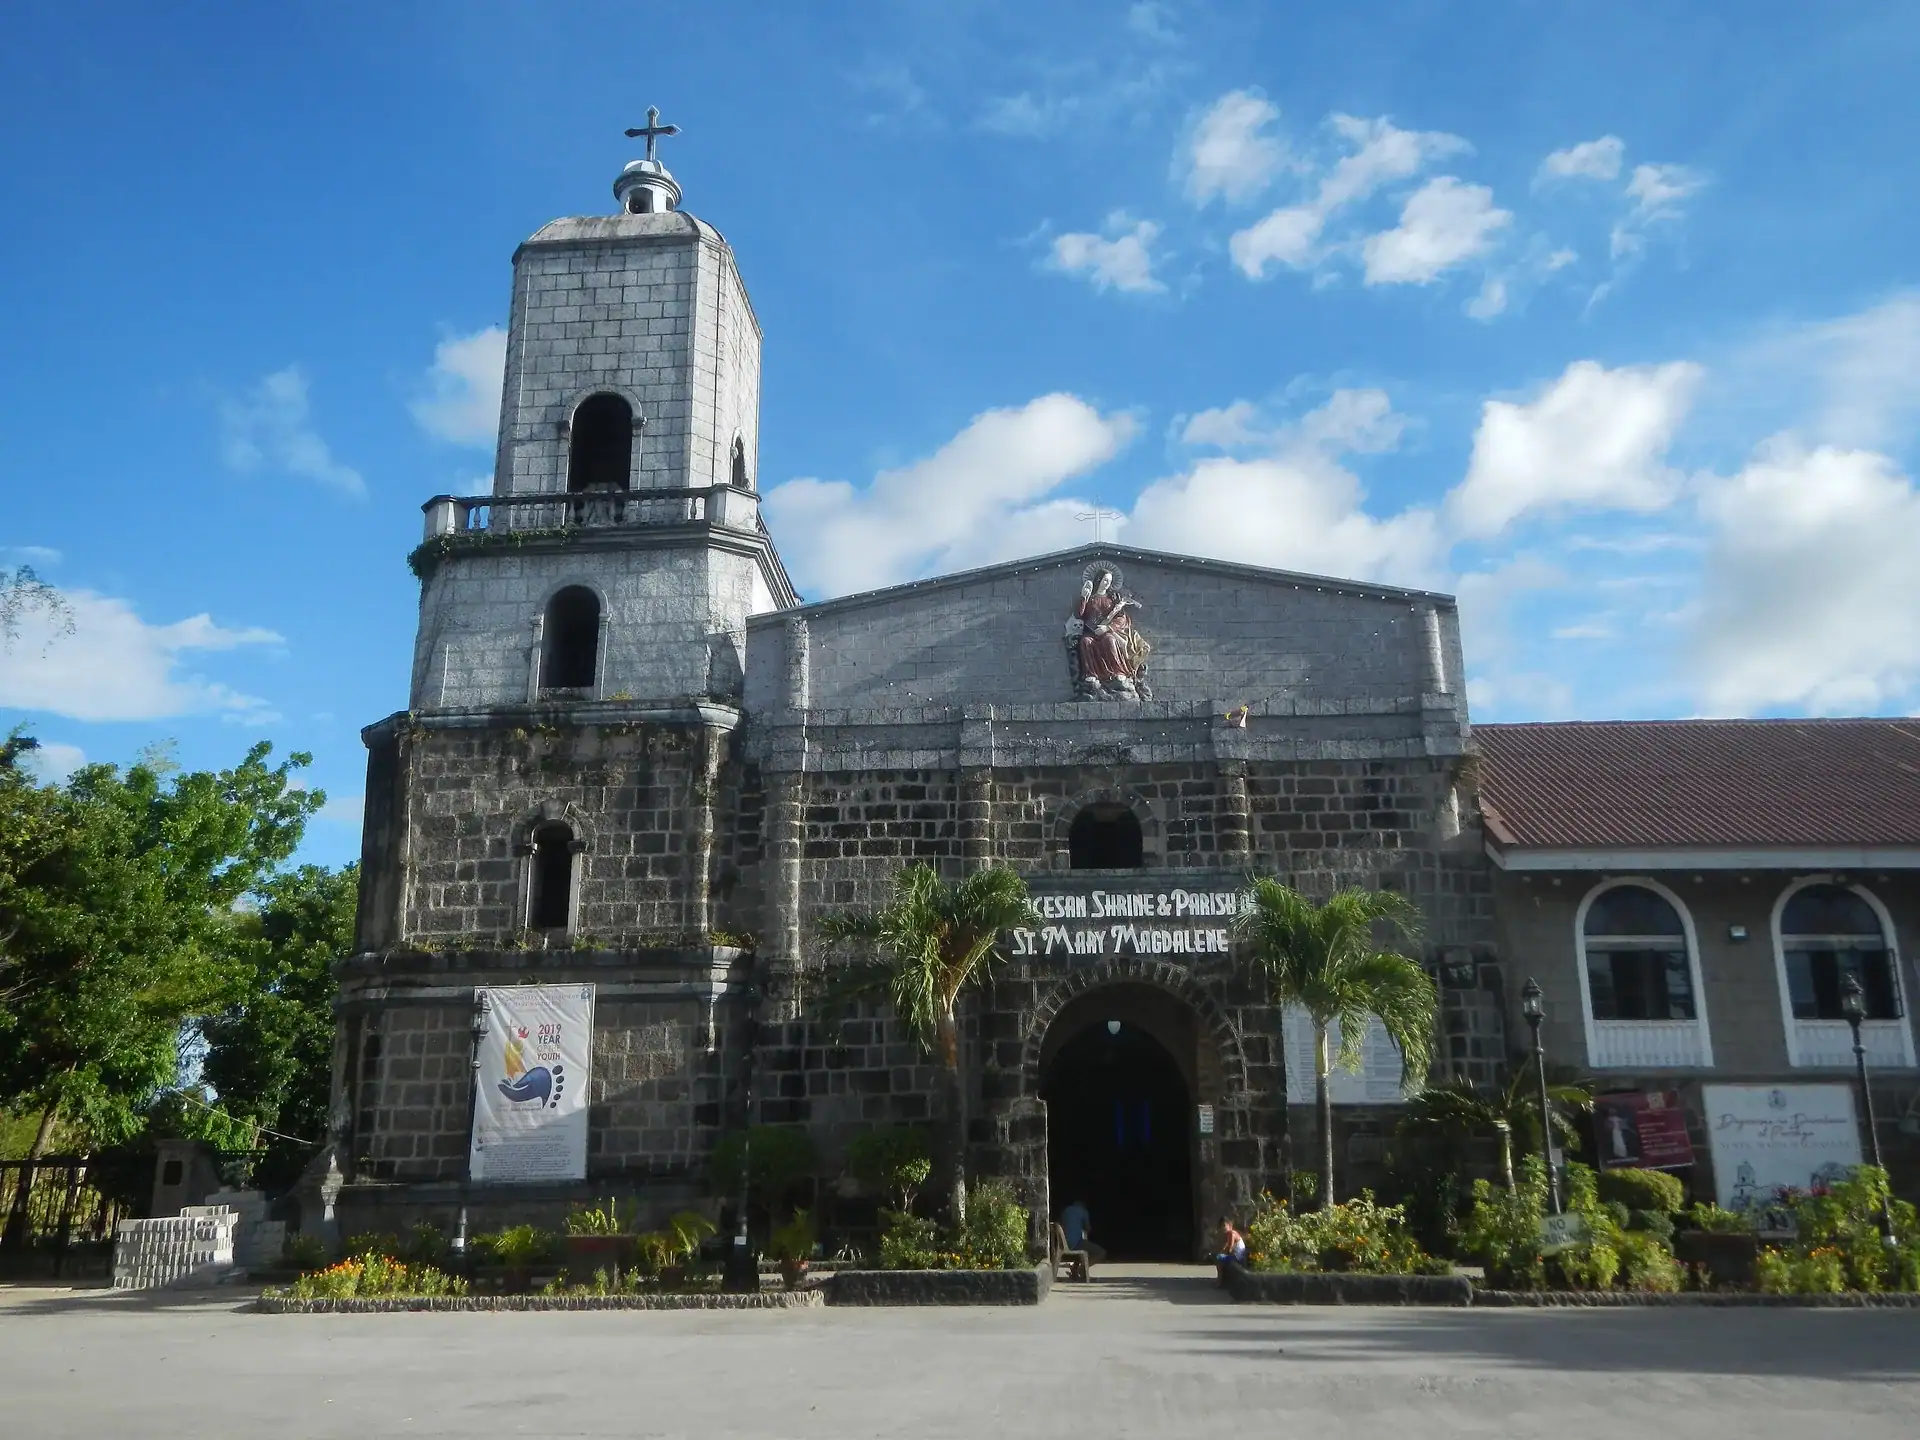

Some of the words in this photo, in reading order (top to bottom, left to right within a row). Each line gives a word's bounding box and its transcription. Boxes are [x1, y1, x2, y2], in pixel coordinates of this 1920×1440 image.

[1091, 891, 1154, 918] SHRINE
[1157, 895, 1171, 916] &
[1171, 889, 1236, 917] PARISH
[1012, 927, 1037, 955] ST.
[1041, 925, 1106, 955] MARY
[1111, 924, 1228, 954] MAGDALENE
[538, 1023, 562, 1035] 2019
[537, 1034, 561, 1044] YEAR
[537, 1053, 561, 1061] YOUTH
[1548, 1218, 1566, 1231] NO
